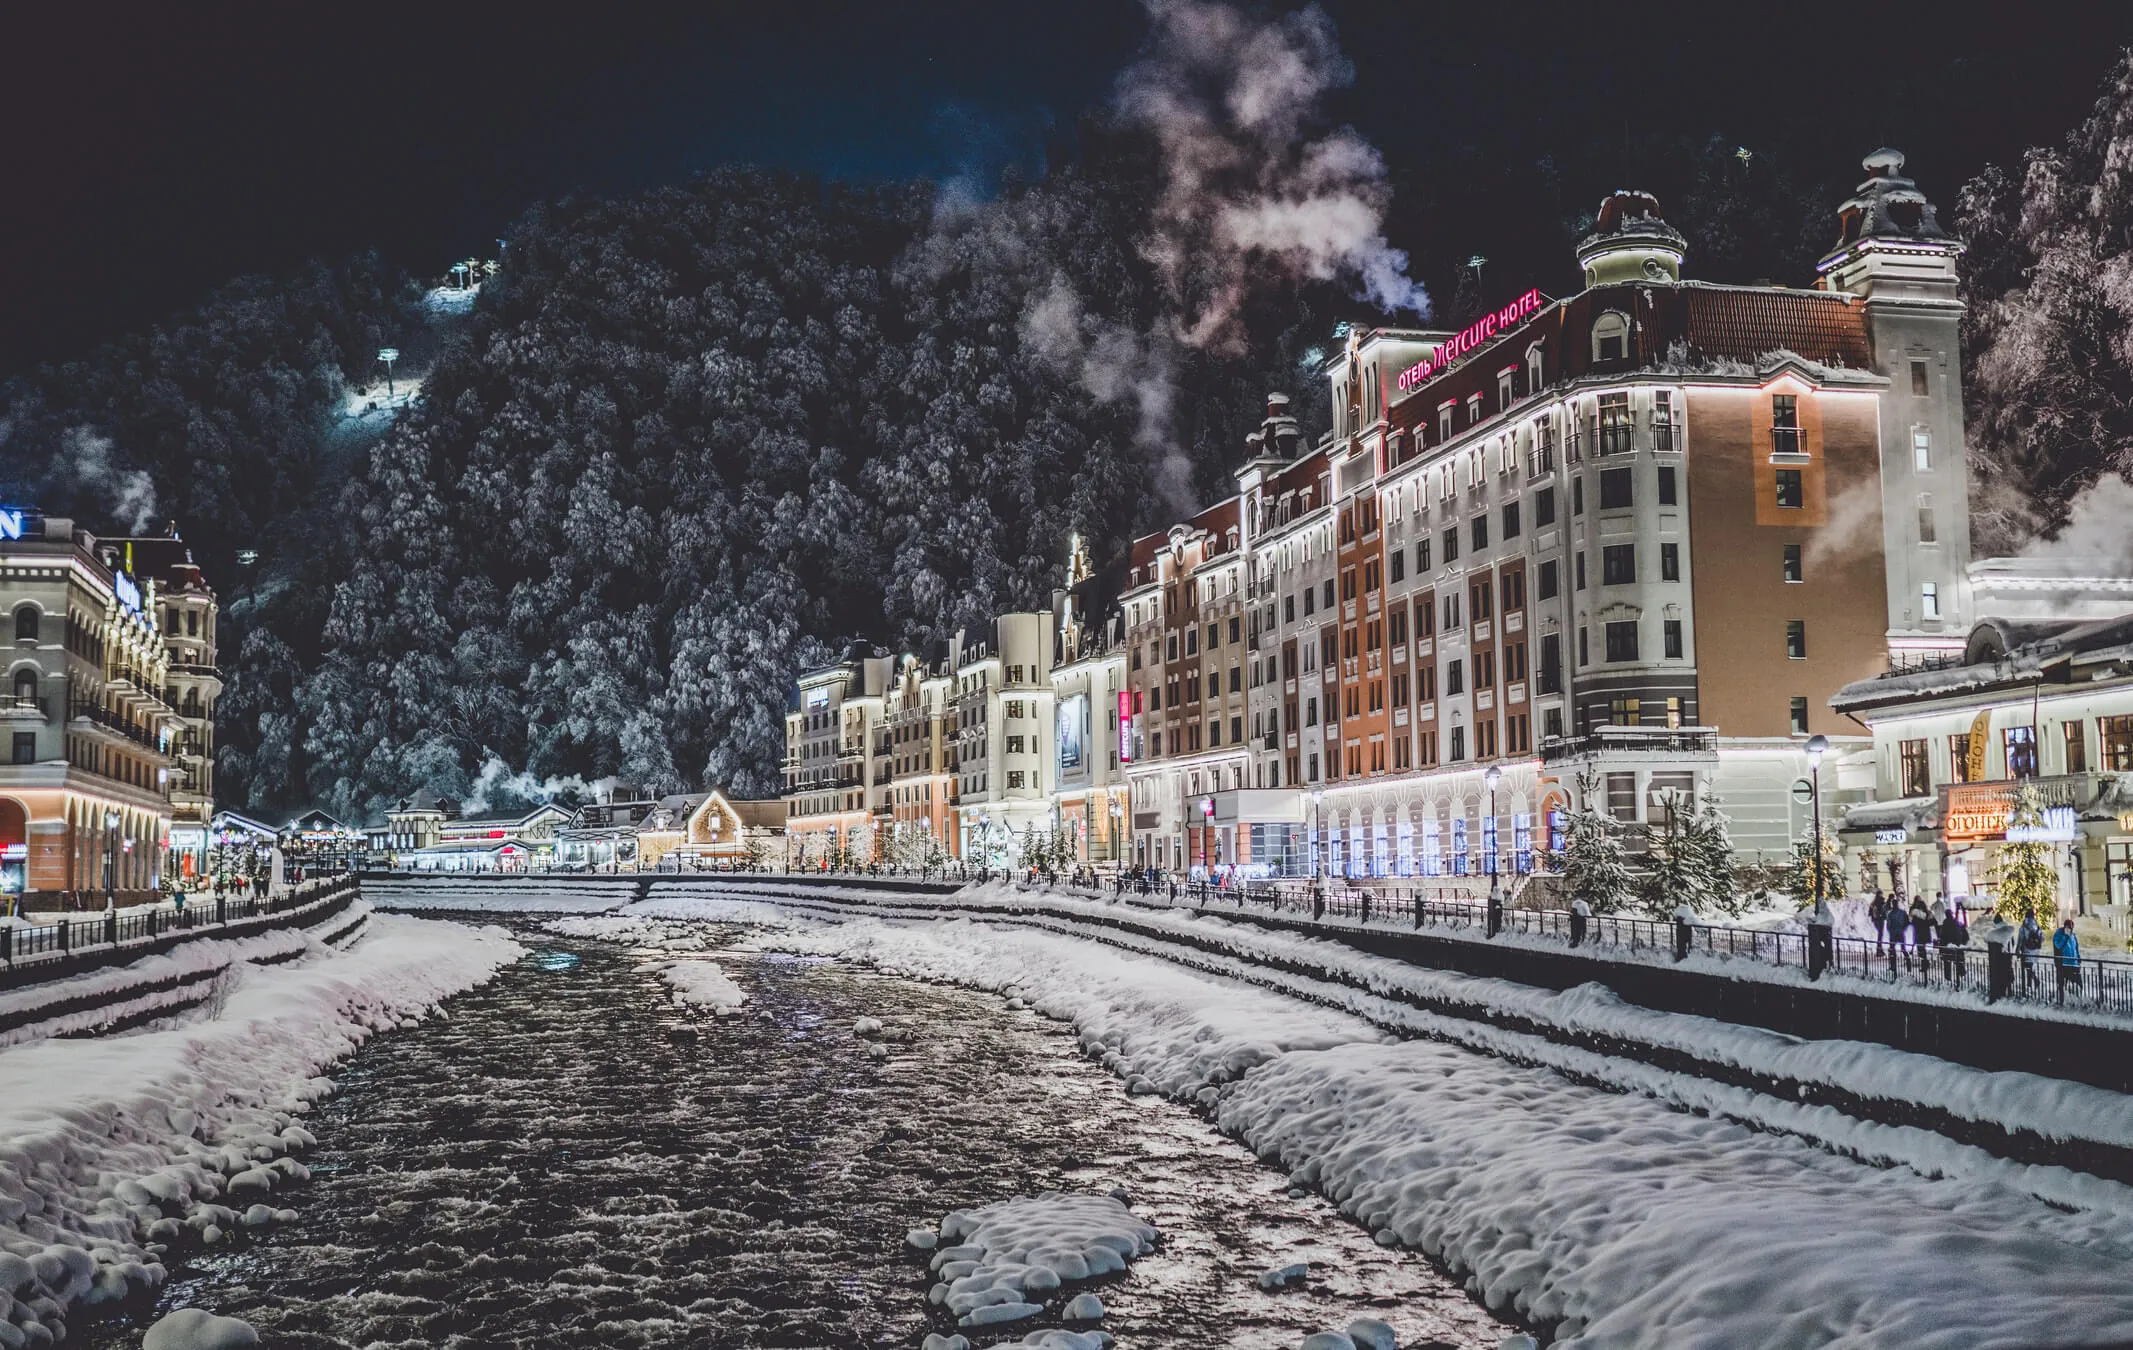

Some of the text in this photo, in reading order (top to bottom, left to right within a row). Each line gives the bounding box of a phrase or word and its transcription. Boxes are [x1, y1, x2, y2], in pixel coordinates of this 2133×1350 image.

[1399, 359, 1431, 390] ОТЕЛЬ
[1500, 288, 1542, 329] HOTEL
[1121, 720, 1129, 759] Mercure
[1971, 720, 1984, 781] ОГОНЕ
